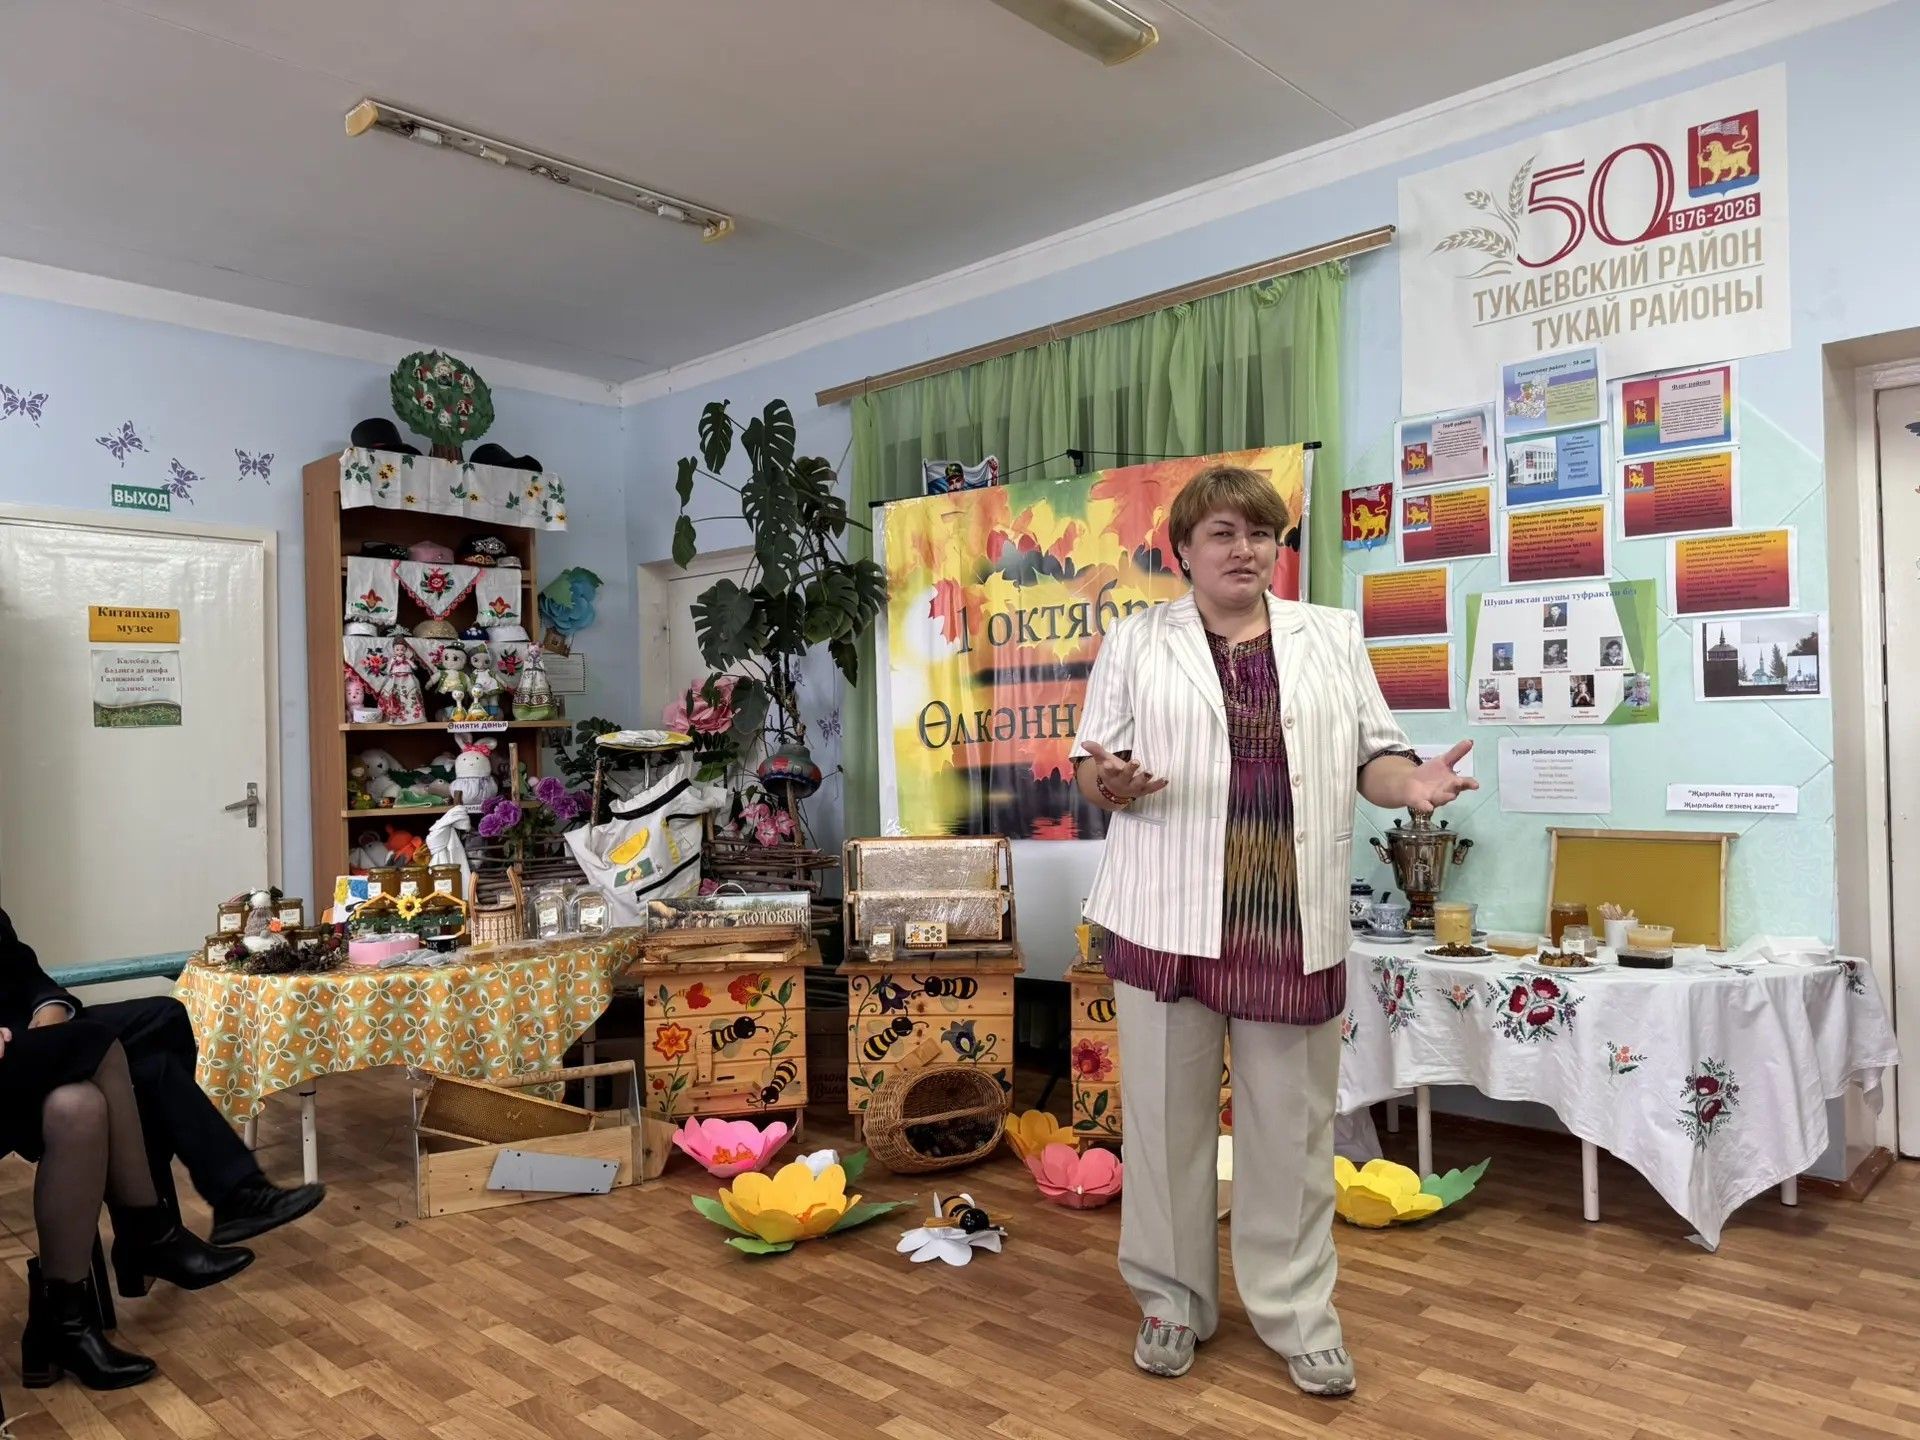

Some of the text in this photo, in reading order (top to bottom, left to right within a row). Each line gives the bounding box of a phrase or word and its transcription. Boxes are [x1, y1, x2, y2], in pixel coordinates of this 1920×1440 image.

[1516, 142, 1675, 268] 50
[1666, 198, 1756, 234] 1976-2026
[1473, 227, 1763, 322] ТУКАЕВСКИЙ РАЙОН
[1532, 275, 1764, 351] ТУКАЙ РАЙОНЫ
[1688, 380, 1711, 388] района
[114, 488, 169, 509] ВЫХОД
[1484, 599, 1513, 607] Шушы
[1542, 594, 1570, 603] шушы
[1571, 589, 1621, 600] туфрактан
[97, 606, 170, 619] Китапханә
[957, 577, 1164, 655] 1 октяб
[117, 624, 154, 635] музее
[448, 722, 480, 730] Әкияти
[918, 700, 1084, 750] Өлкәнн
[1557, 748, 1596, 756] язучылары:
[1684, 801, 1724, 809] Җырлыйм
[743, 908, 808, 925] СОТОВЫЙ
